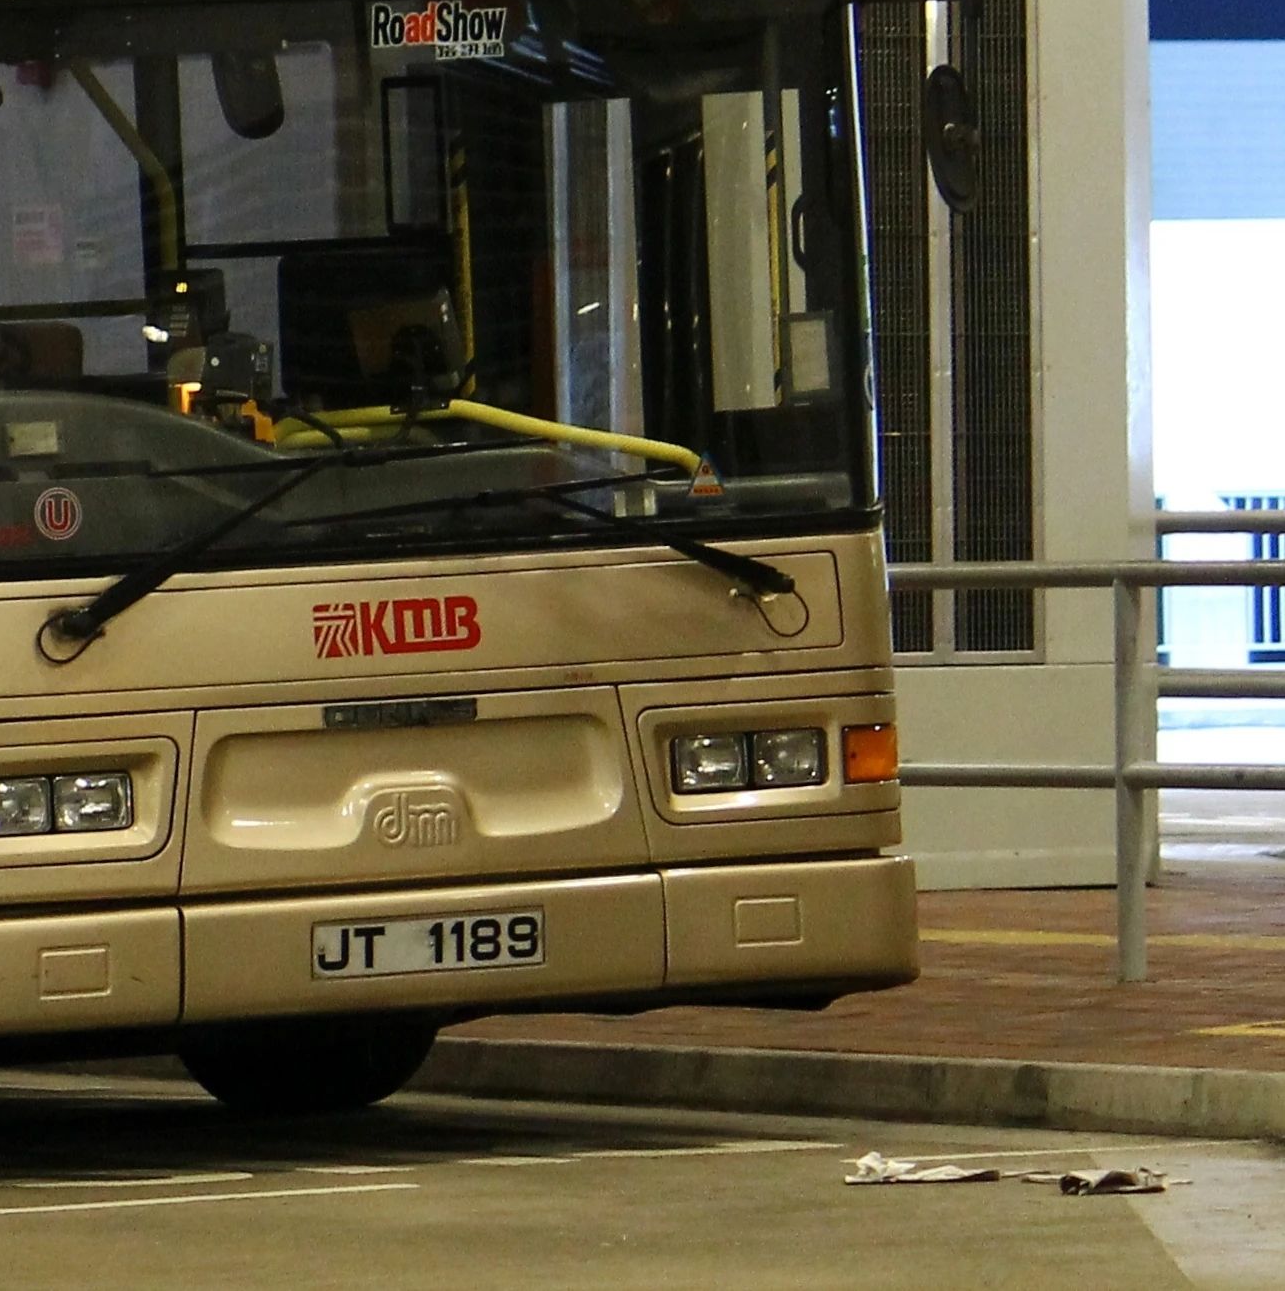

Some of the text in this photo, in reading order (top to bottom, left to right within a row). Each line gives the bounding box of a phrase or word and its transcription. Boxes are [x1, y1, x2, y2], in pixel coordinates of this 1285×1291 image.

[359, 595, 482, 657] KMB
[316, 915, 539, 971] JT 1189
